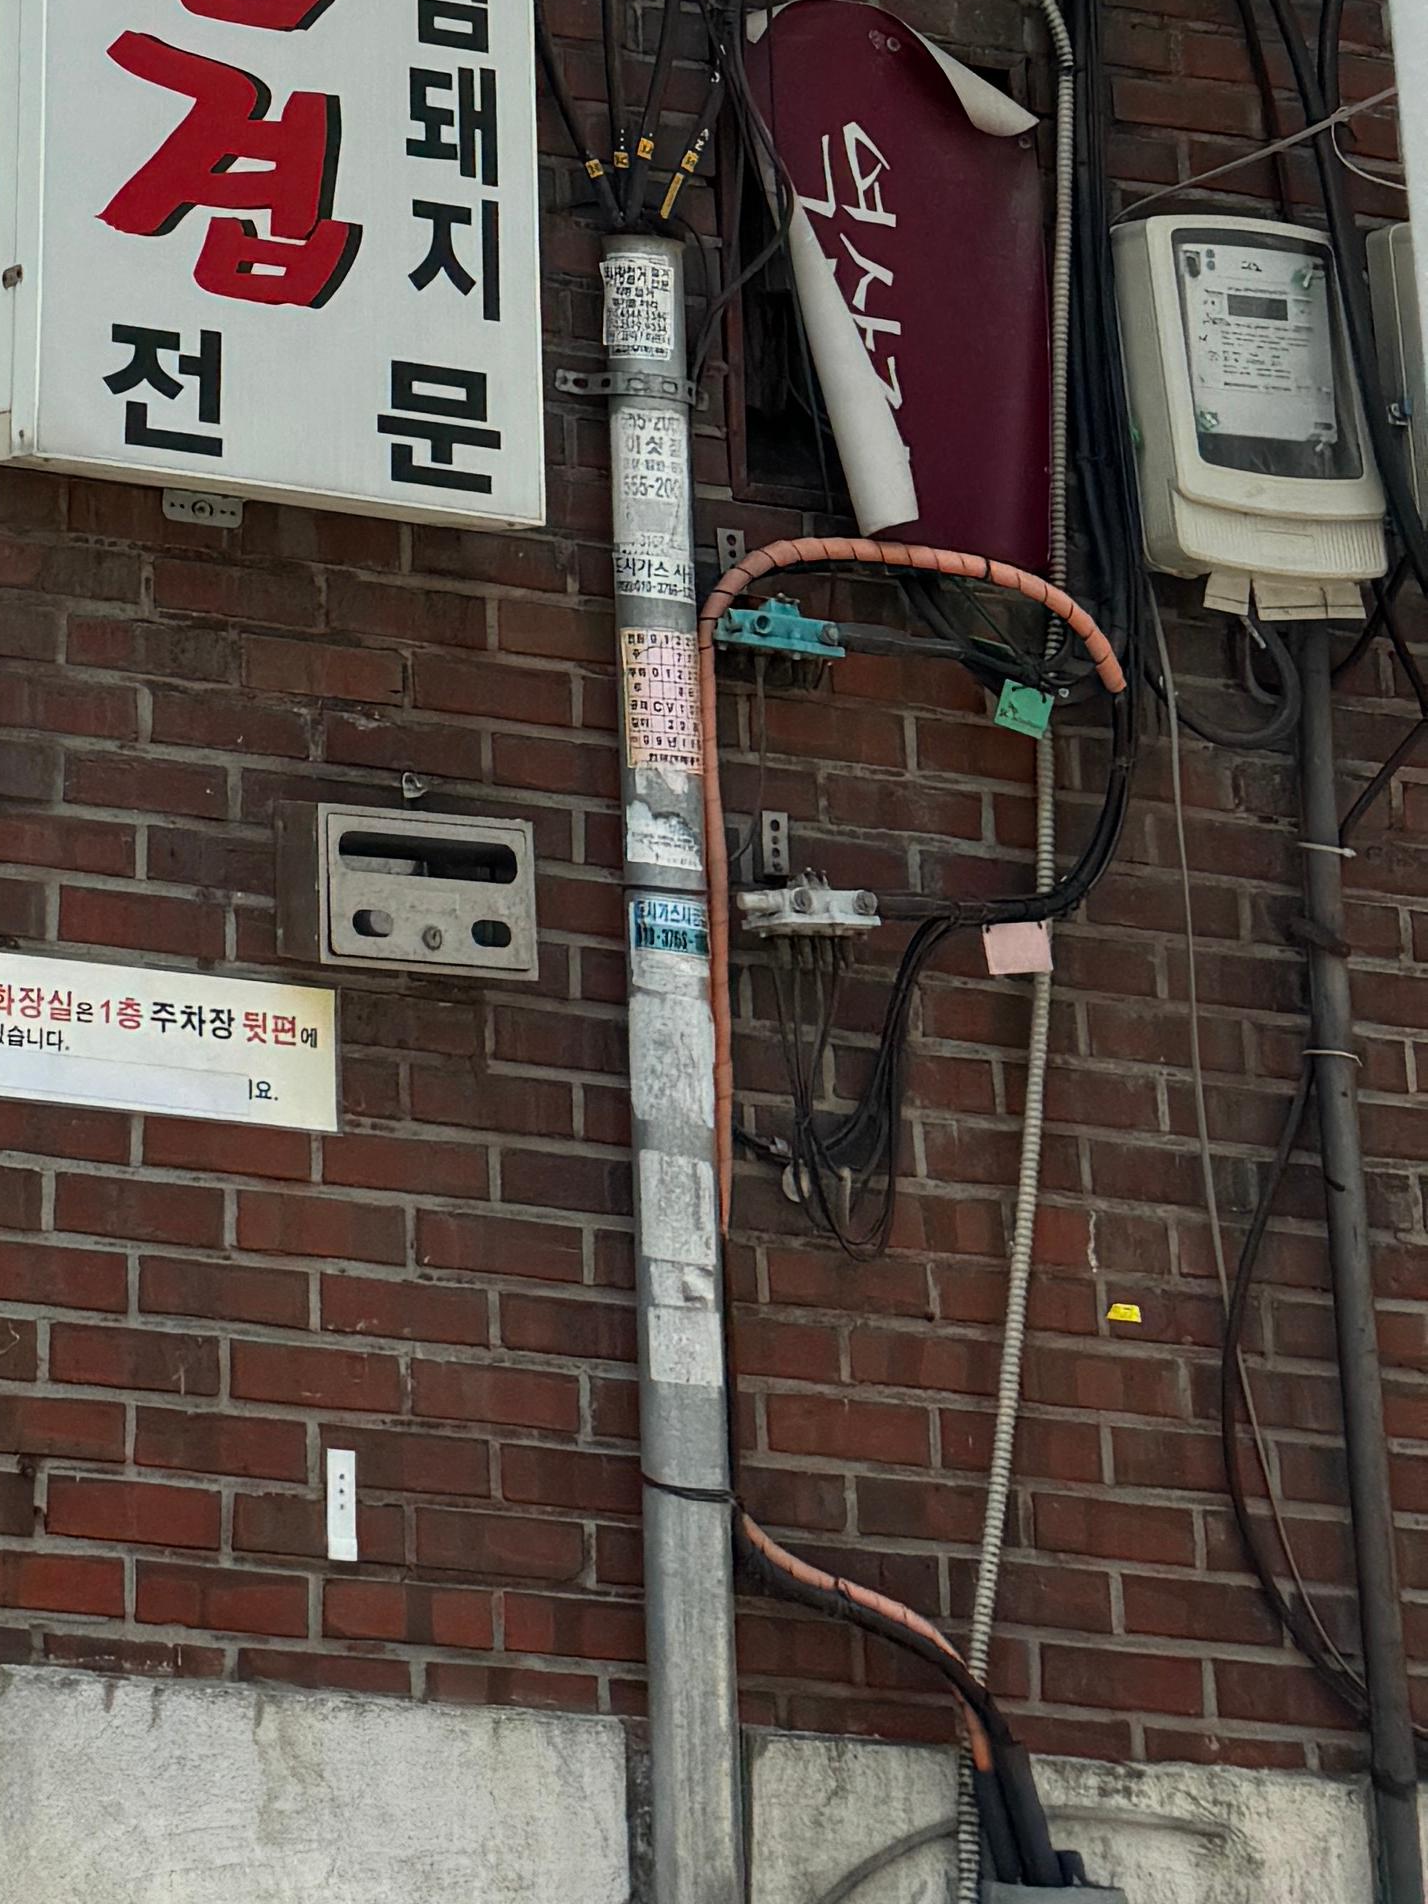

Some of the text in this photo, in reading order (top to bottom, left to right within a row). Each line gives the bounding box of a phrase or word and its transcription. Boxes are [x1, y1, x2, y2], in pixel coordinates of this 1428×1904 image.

[99, 997, 143, 1030] 1층
[150, 1001, 235, 1040] 주차장
[242, 1011, 318, 1049] 뒷편에
